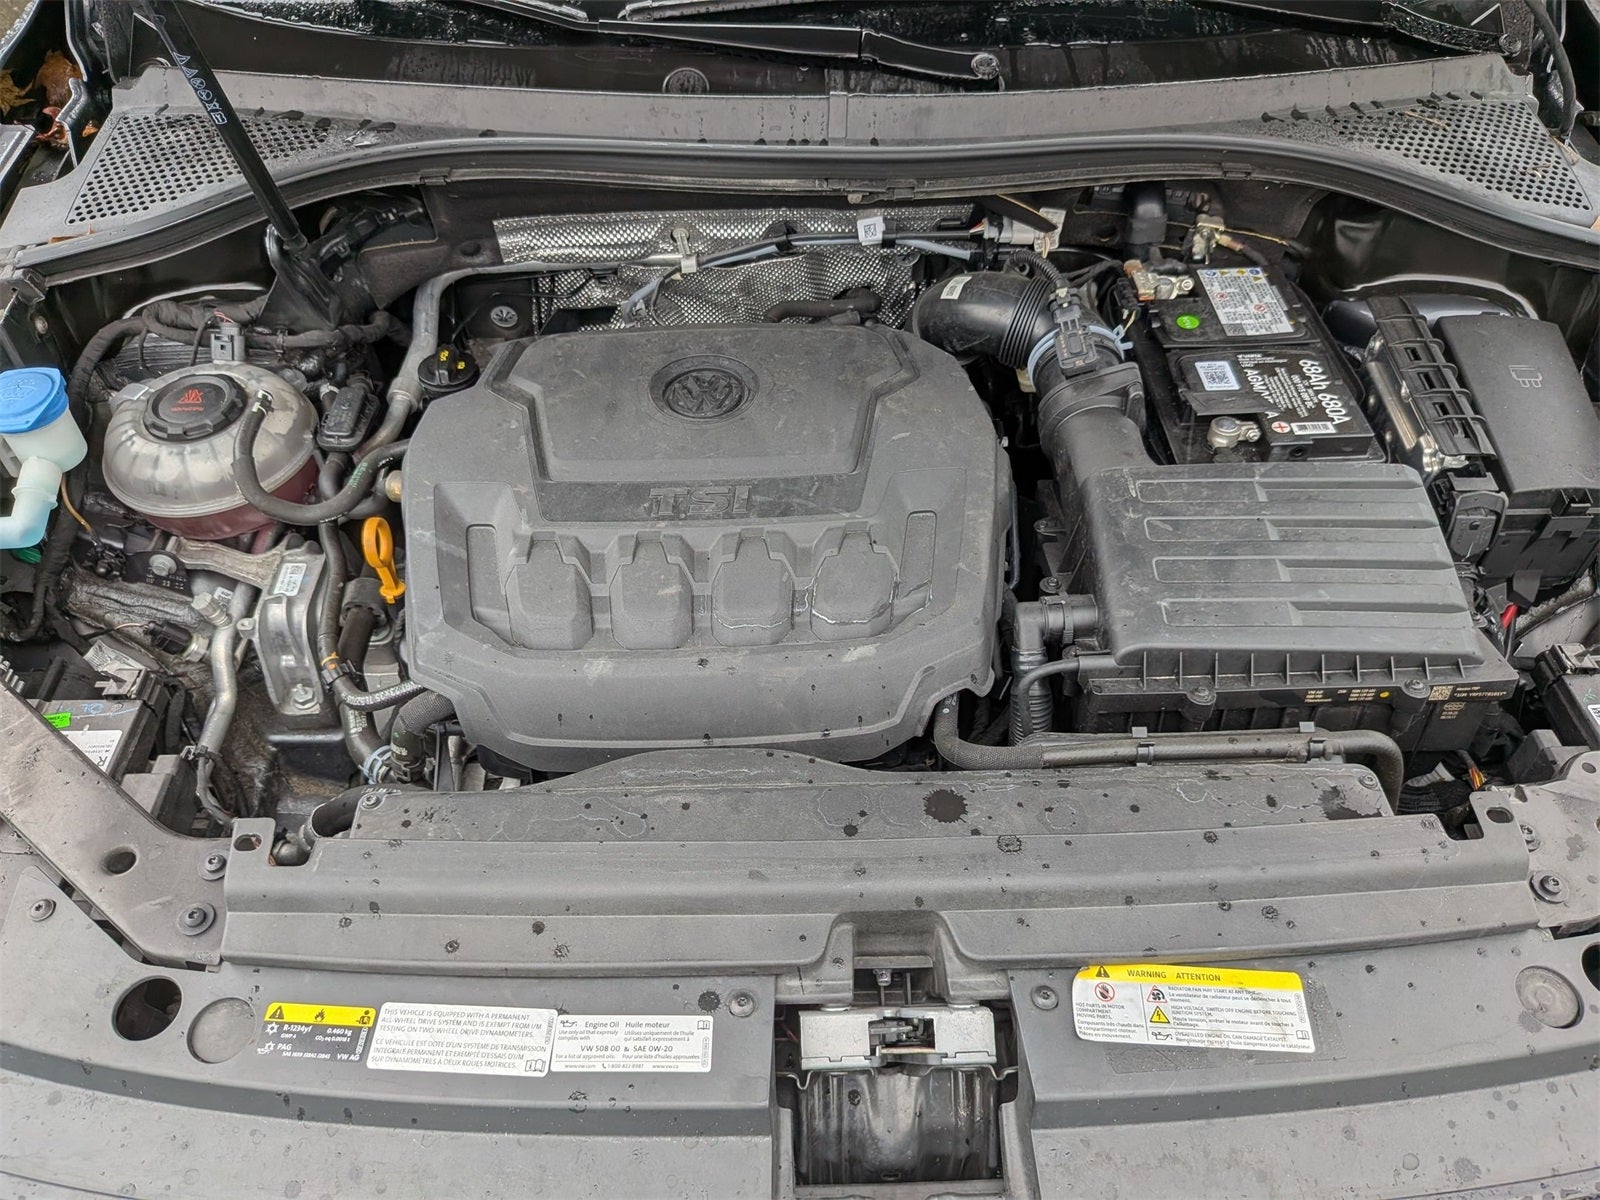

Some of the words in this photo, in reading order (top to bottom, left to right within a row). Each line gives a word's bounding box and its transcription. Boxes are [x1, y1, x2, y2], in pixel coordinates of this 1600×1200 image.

[1299, 359, 1331, 390] 68Ah
[1318, 393, 1352, 425] 680A
[649, 485, 752, 516] TSI
[1127, 969, 1166, 978] WARNING
[1176, 972, 1221, 981] ATTENTION
[283, 1024, 312, 1034] R-1234yf
[380, 1024, 406, 1032] TESTING
[585, 1021, 608, 1030] Engine
[500, 1044, 546, 1052] TRANSMISSION
